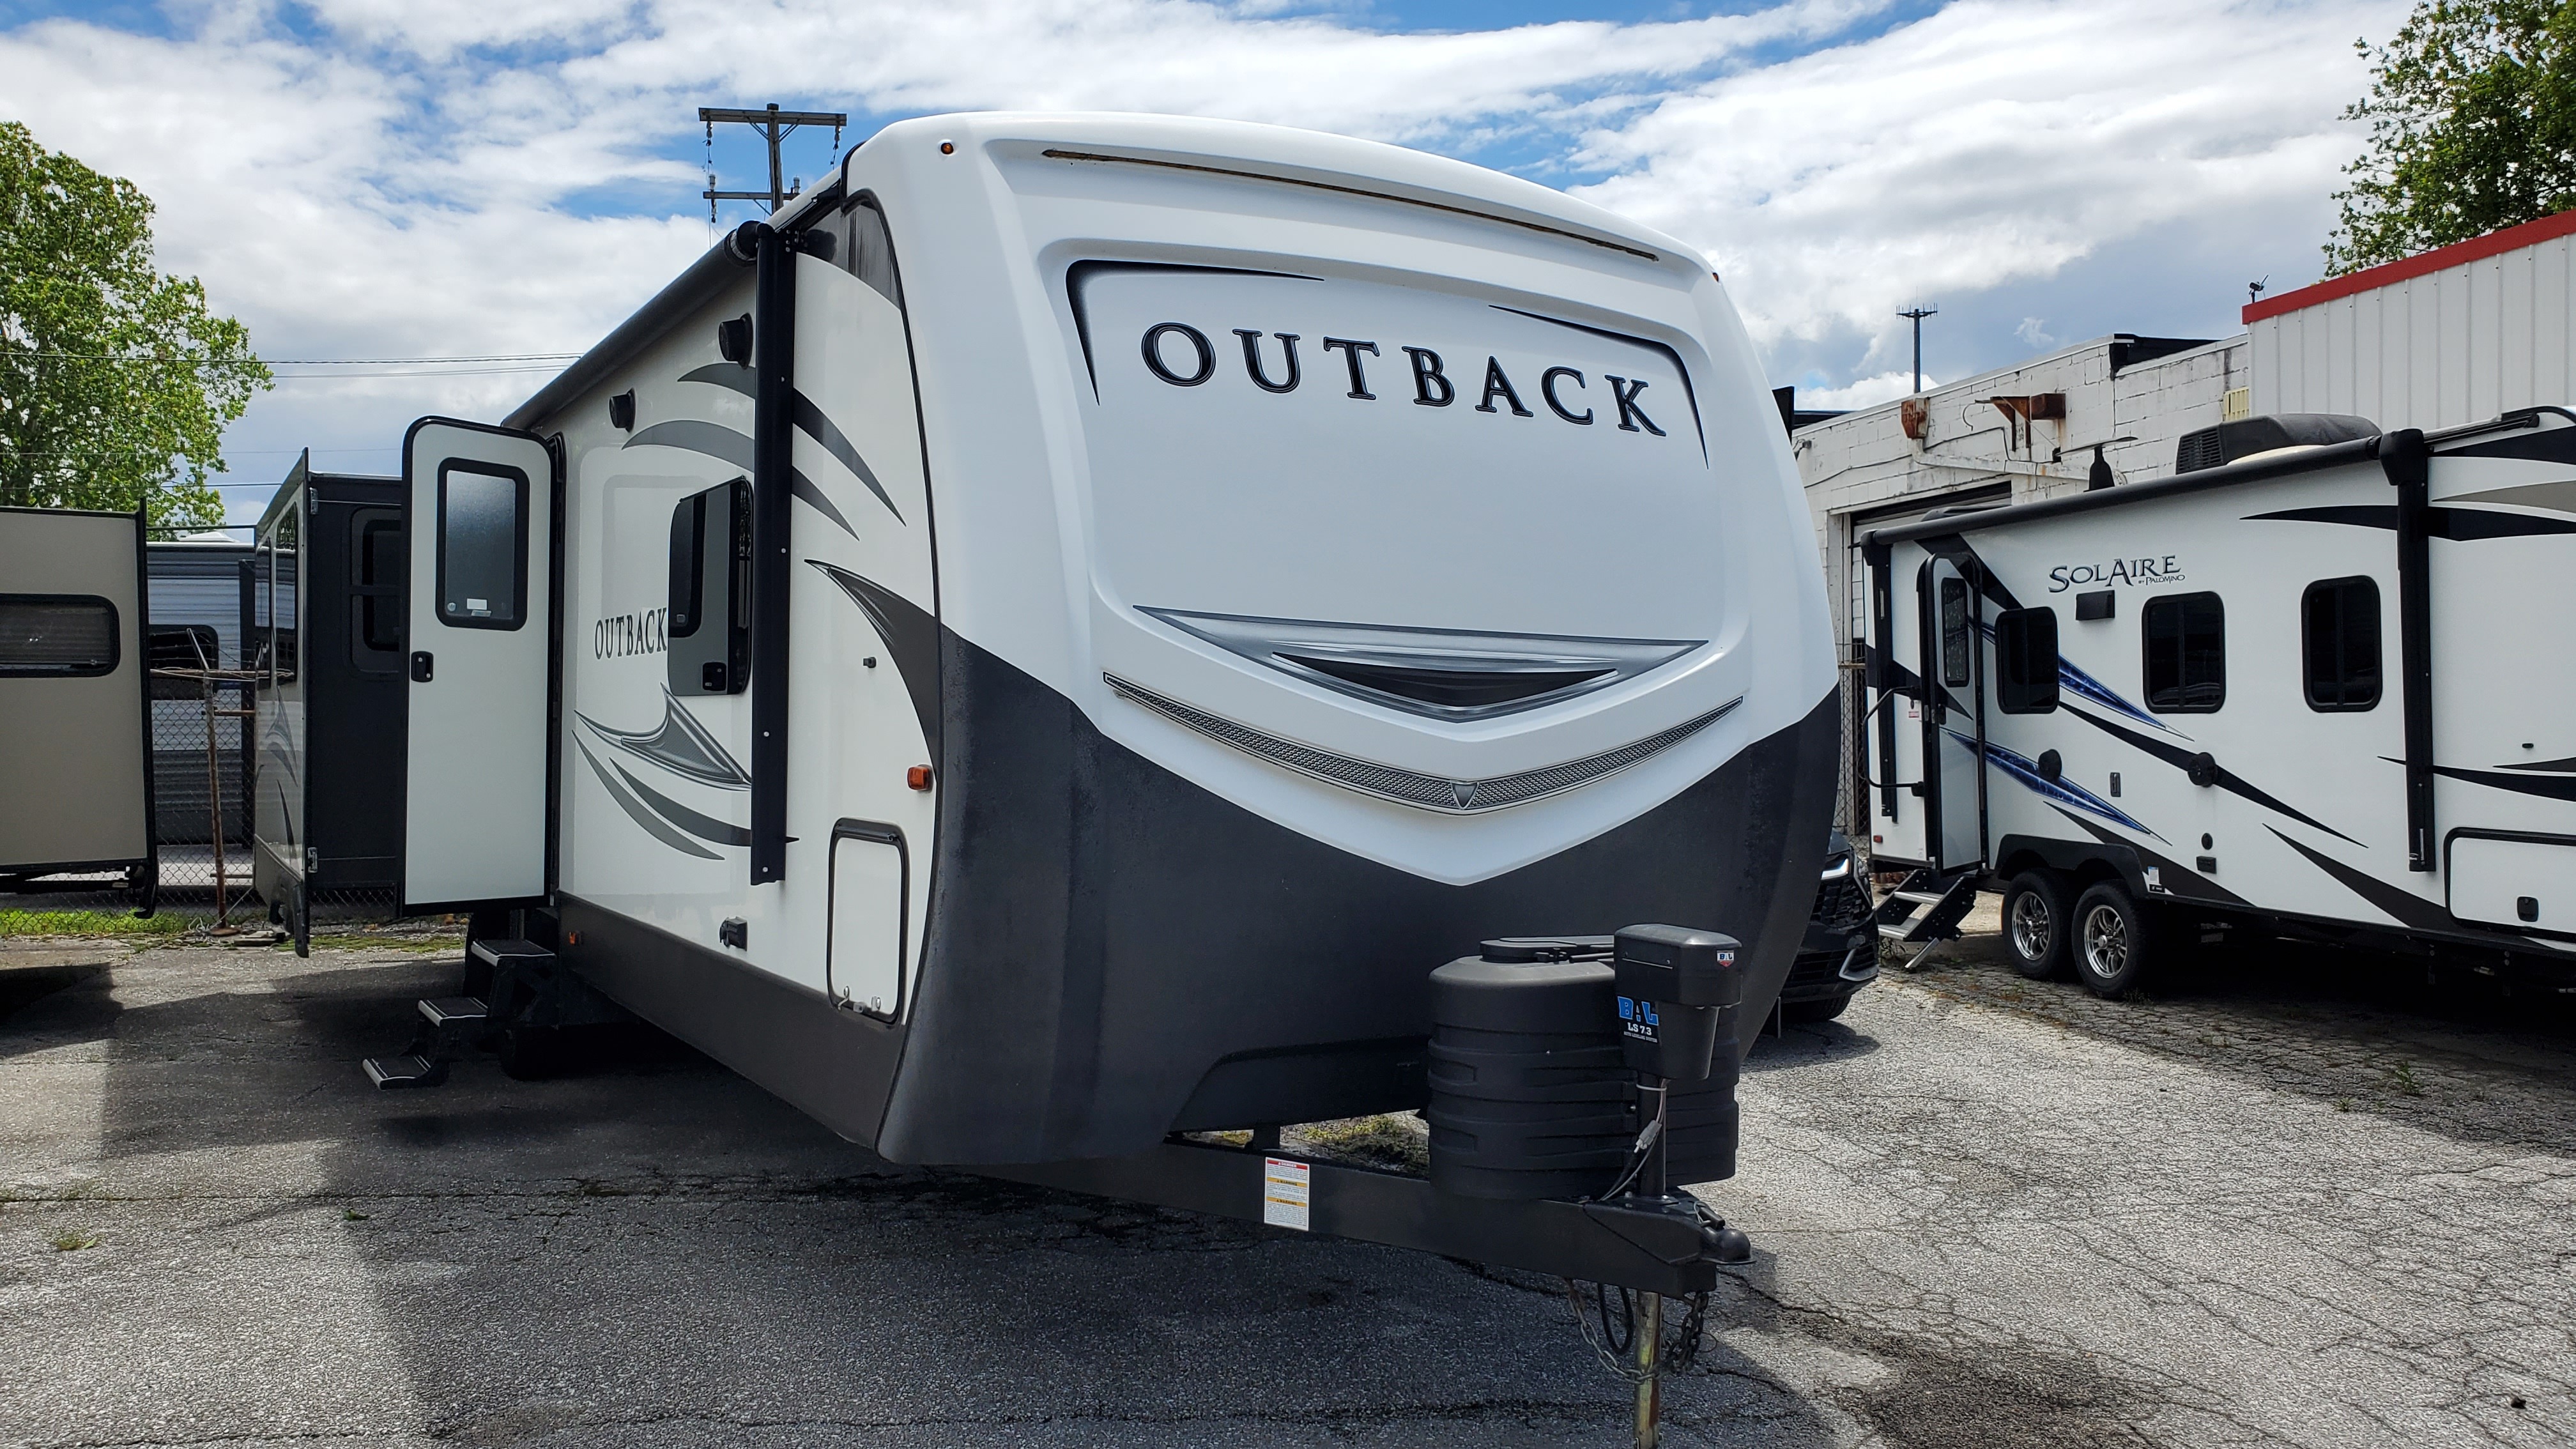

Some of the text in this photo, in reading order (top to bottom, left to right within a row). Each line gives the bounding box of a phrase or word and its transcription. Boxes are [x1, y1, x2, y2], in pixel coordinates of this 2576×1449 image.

[1141, 321, 1667, 437] OUTBACK
[2145, 574, 2186, 585] PALOMINO
[595, 607, 667, 659] OUTBACK
[1618, 996, 1659, 1026] BAL
[1627, 1022, 1639, 1032] LS
